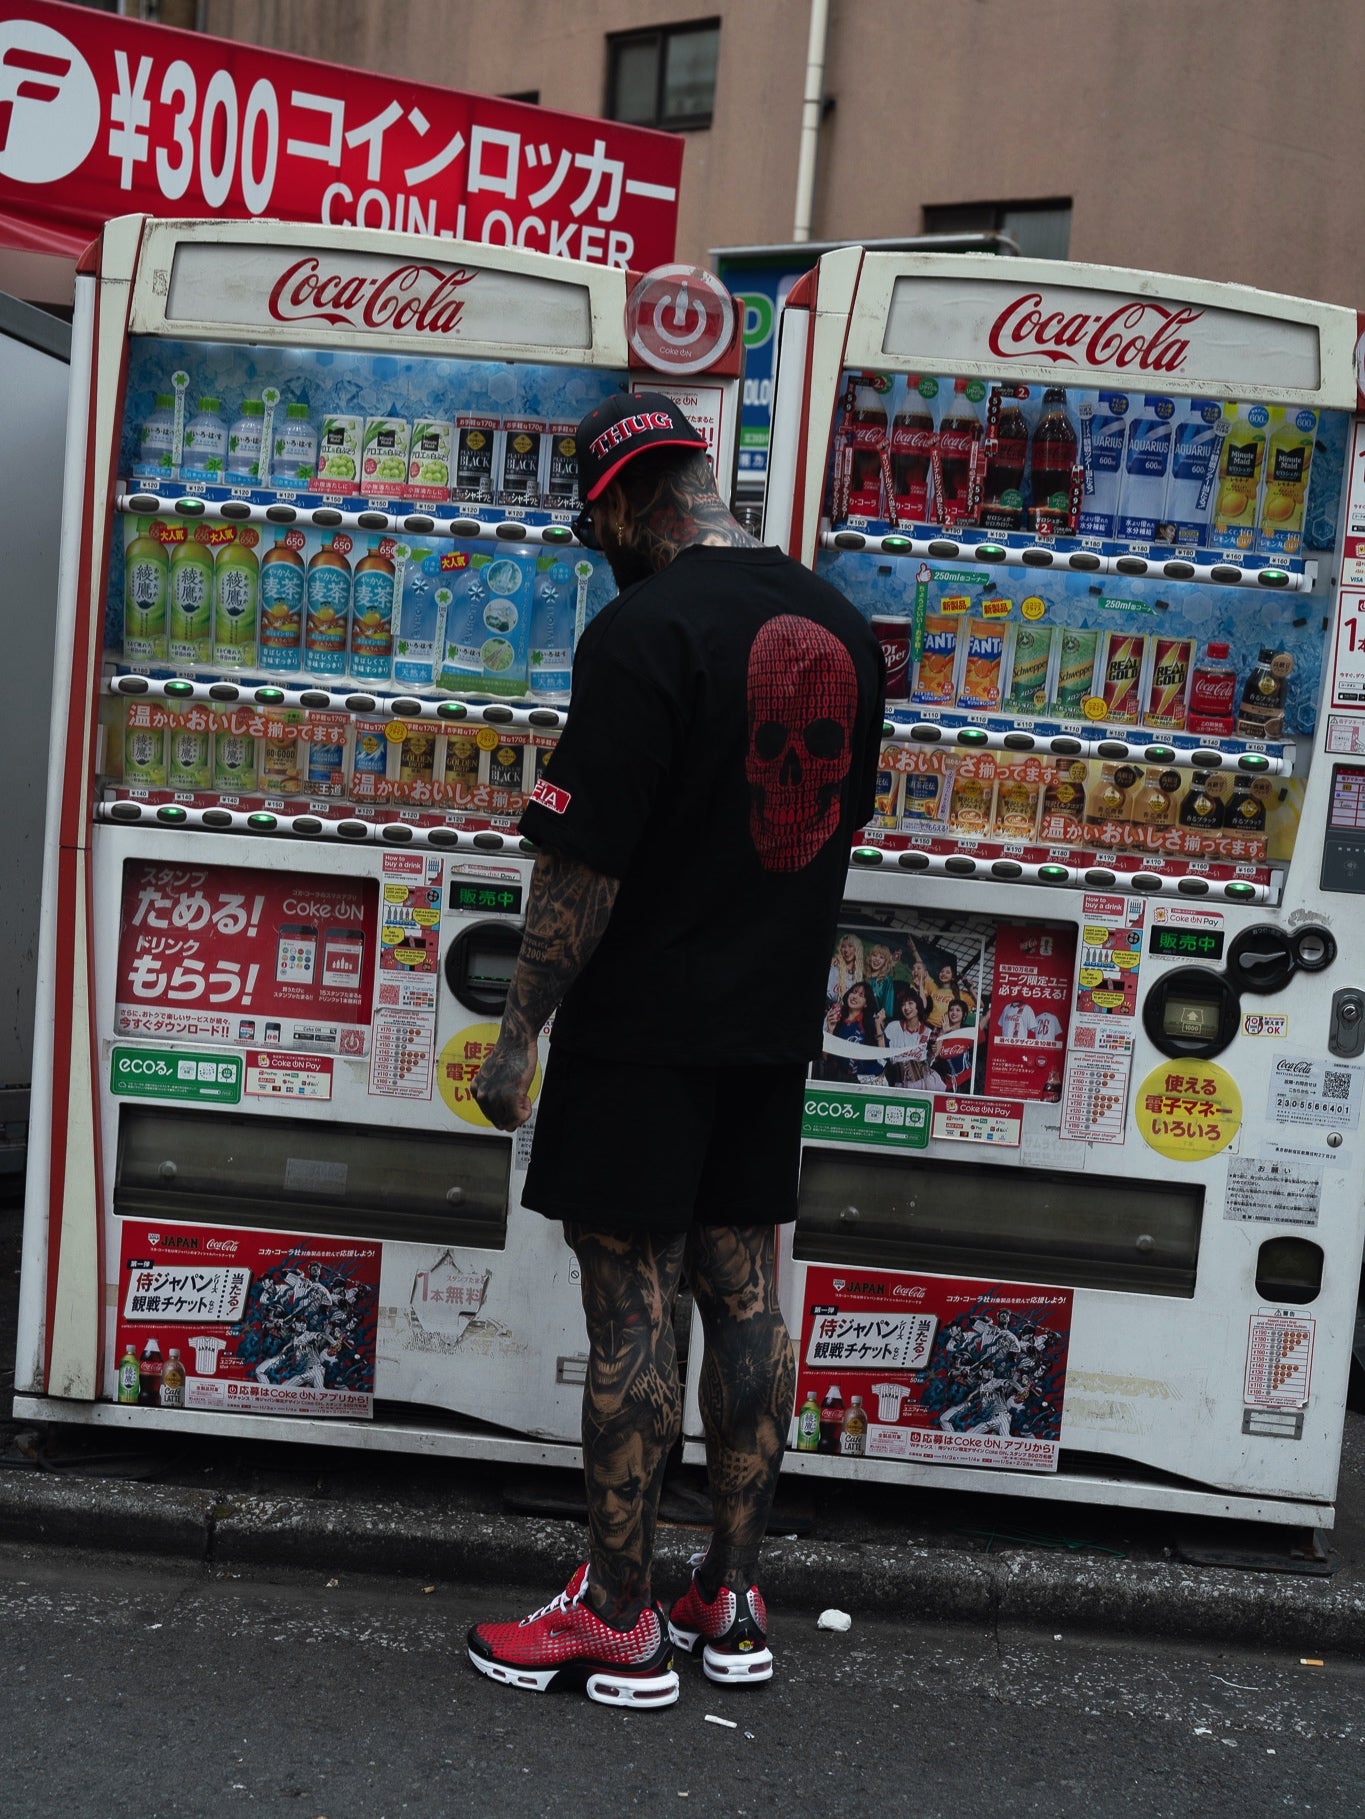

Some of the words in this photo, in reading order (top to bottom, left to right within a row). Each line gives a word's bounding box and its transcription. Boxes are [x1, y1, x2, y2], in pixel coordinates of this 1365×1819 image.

[110, 49, 279, 215] ¥300
[286, 90, 677, 223] コインロッカー
[269, 257, 479, 335] Coca-Cola
[988, 293, 1206, 374] Coca-Cola
[660, 347, 678, 356] Coke
[589, 412, 673, 460] THUG
[1128, 439, 1169, 453] AQUARIUS
[1175, 444, 1211, 457] AQUARIU
[1231, 450, 1254, 459] Minute
[1233, 456, 1251, 465] Maid
[1278, 455, 1302, 464] Minute
[1280, 462, 1299, 471] Maid
[287, 537, 304, 547] 650
[333, 541, 351, 551] 650
[263, 578, 300, 600] 麦茶
[309, 581, 347, 603] 麦茶
[355, 586, 393, 608] 麦茶
[1110, 659, 1139, 671] REAL
[1157, 662, 1185, 675] REAL
[1109, 669, 1139, 681] GOLD
[1156, 673, 1184, 686] GOLD
[1196, 679, 1233, 698] Coca-Cola
[129, 703, 347, 745] 温かいおいしさ揃ってます。
[491, 771, 521, 783] BLACK
[320, 783, 342, 797] 王道
[1043, 815, 1273, 862] 温かいおいしさ揃ってます。
[385, 860, 395, 868] buy
[141, 867, 208, 888] スタンプ
[460, 888, 514, 907] 販売中
[132, 886, 265, 937] ためる!
[283, 899, 331, 917] Coke
[1085, 902, 1098, 910] buy
[1105, 903, 1123, 911] drink
[1170, 915, 1190, 923] Coke
[1203, 918, 1219, 927] Pay
[135, 935, 200, 957] ドリンク
[1160, 933, 1216, 952] 販売中
[128, 955, 261, 1006] もらう!
[1000, 973, 1068, 988] コーク限定ユニ
[998, 984, 1066, 1001] 必ずもらえる!
[306, 1062, 321, 1071] Pay
[1277, 1059, 1314, 1074] Coca-Cola
[1165, 1074, 1218, 1095] 使える
[960, 1104, 980, 1113] Coke
[995, 1108, 1011, 1117] Pay
[1145, 1095, 1233, 1118] 電子マネー
[1151, 1119, 1221, 1141] いろいろ
[161, 1236, 198, 1248] JAPAN
[136, 1272, 214, 1293] 侍ジャパン
[846, 1282, 885, 1294] JAPAN
[131, 1295, 208, 1313] 観戦チケット
[819, 1318, 899, 1339] 侍ジャパン
[814, 1342, 892, 1360] 観戦チケット
